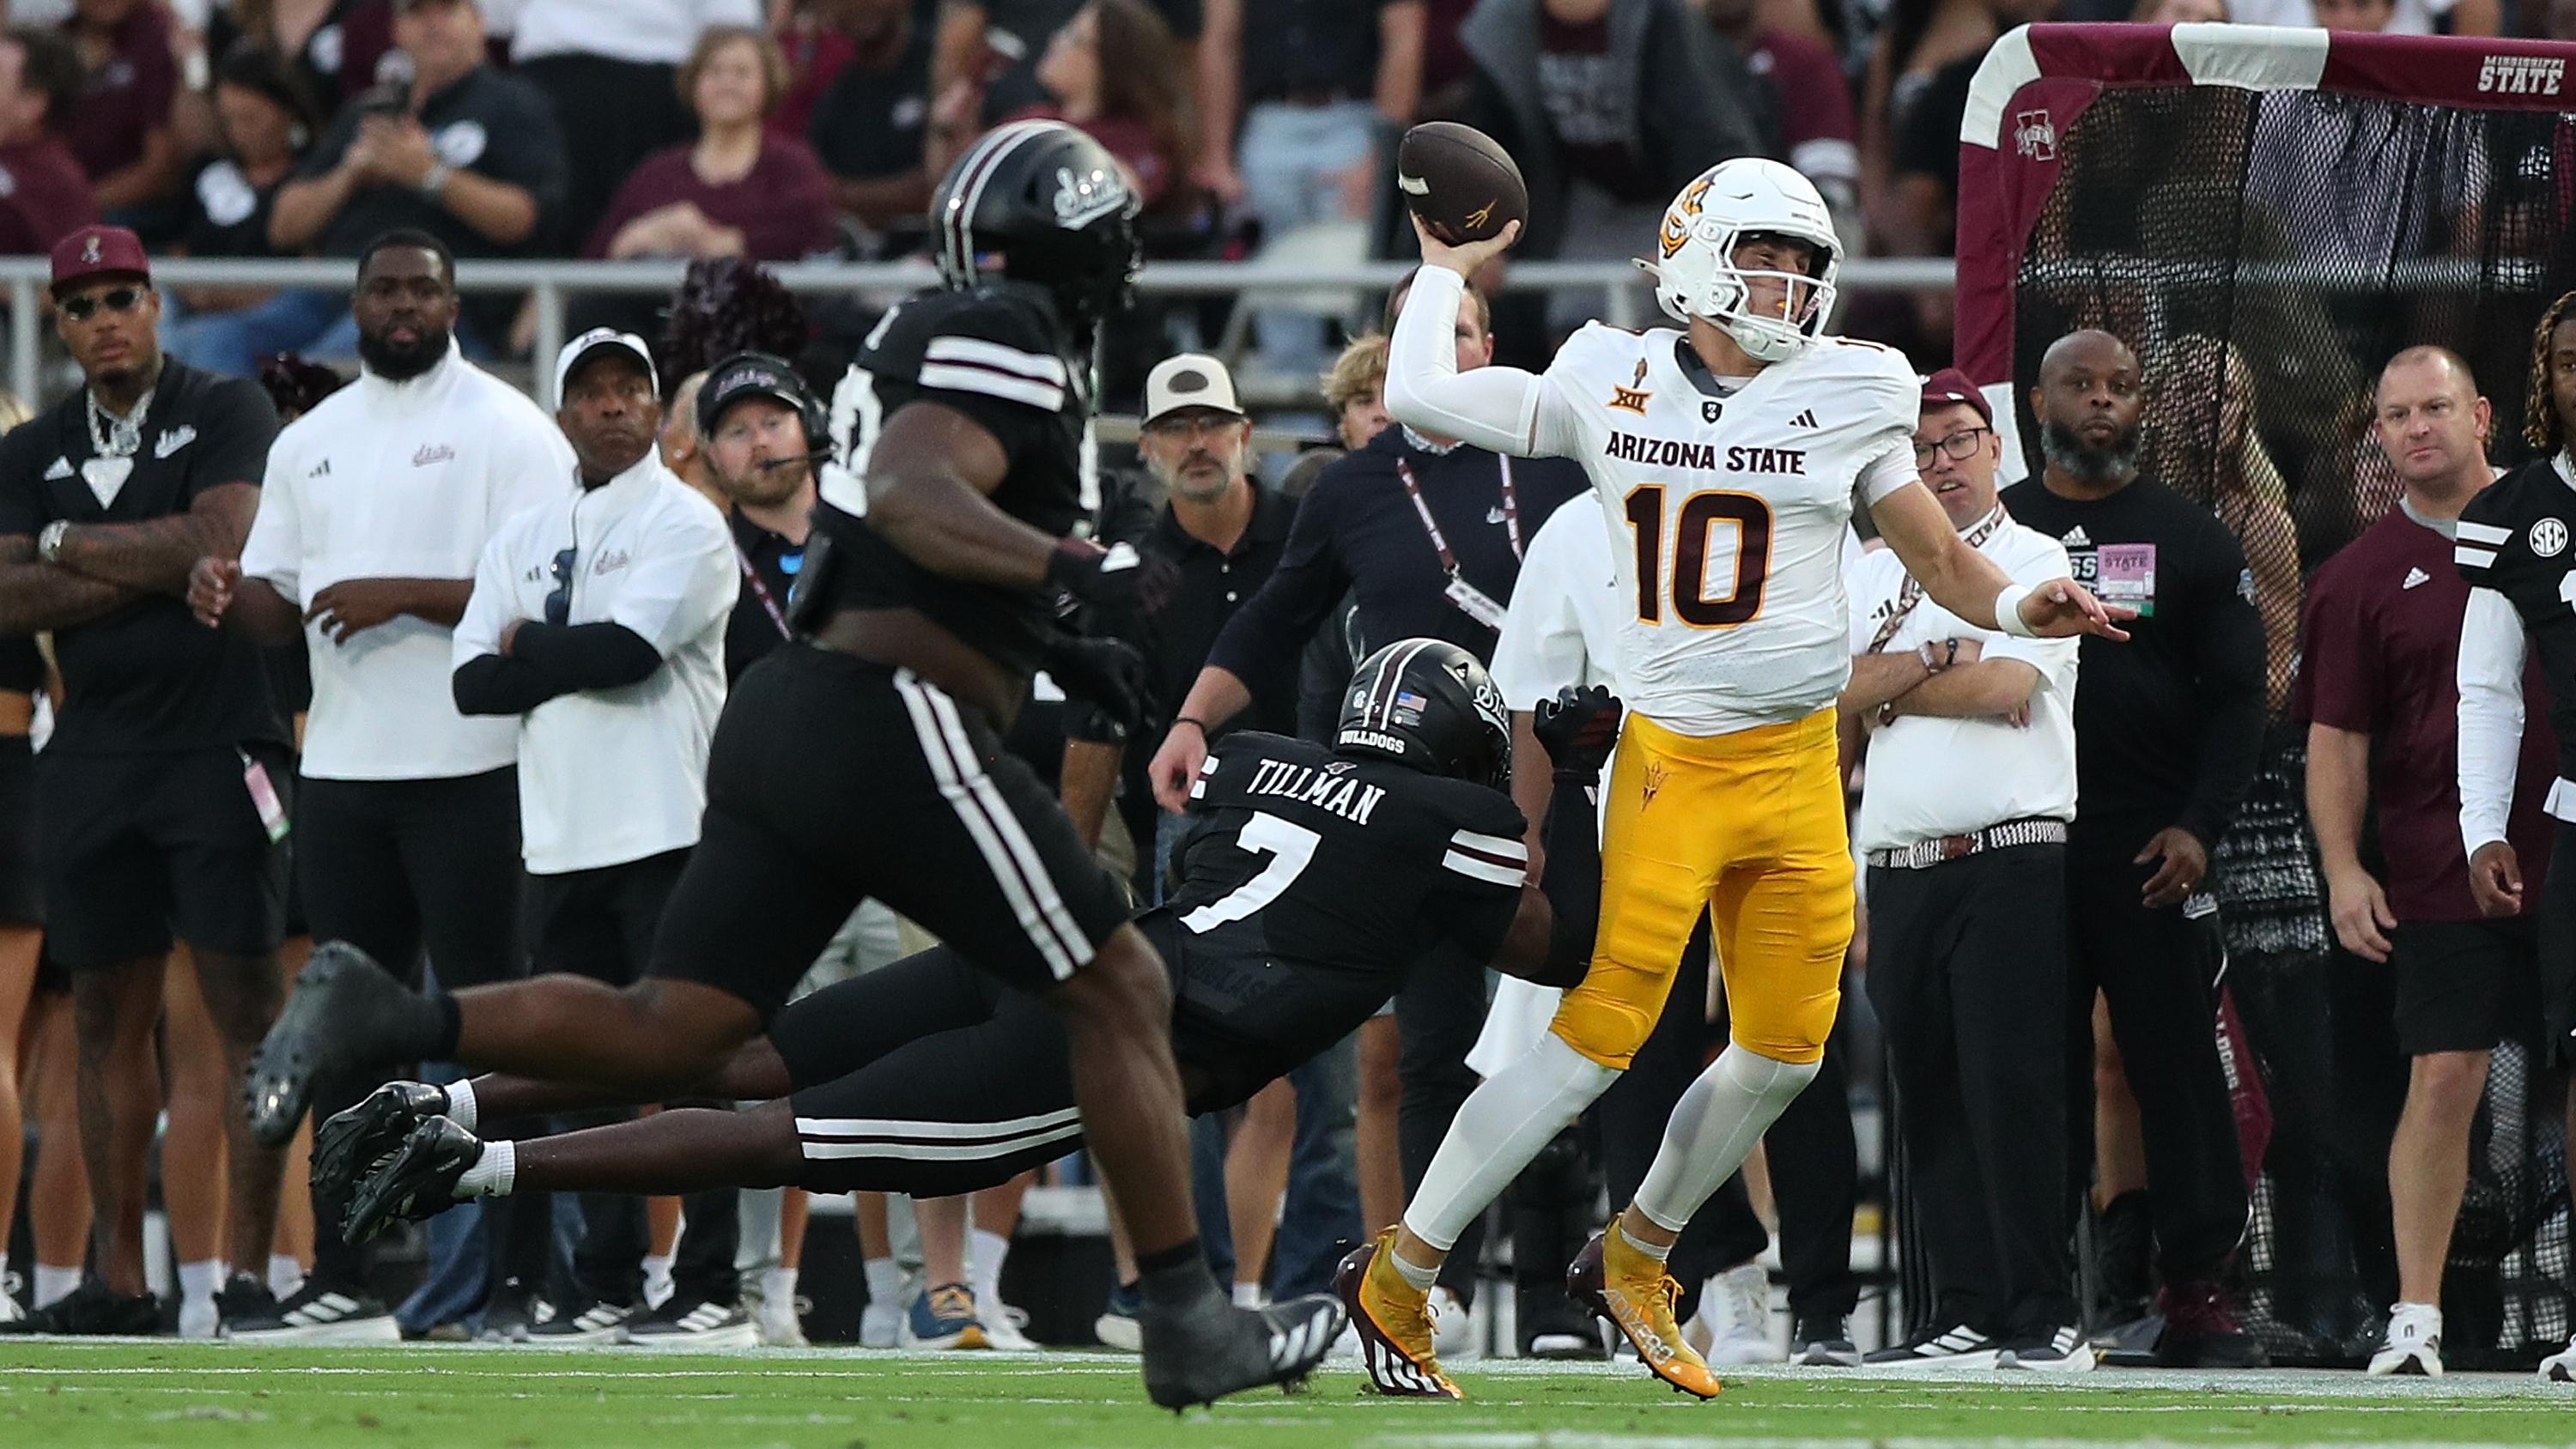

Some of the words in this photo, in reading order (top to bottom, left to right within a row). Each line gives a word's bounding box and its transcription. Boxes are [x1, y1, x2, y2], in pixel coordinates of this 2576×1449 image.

[2477, 66, 2563, 95] STATE
[2483, 55, 2566, 69] MISSISSIPPI
[1605, 383, 1654, 417] XII
[1605, 430, 1716, 471] ARIZONA
[1726, 446, 1807, 476] STATE
[1622, 482, 1776, 630] 10
[2533, 521, 2564, 555] SEC
[1339, 730, 1406, 755] BULLDOGS
[1246, 758, 1387, 826] TILLMAN
[1178, 810, 1322, 935] 7
[1595, 1288, 1676, 1365] ADIZERO
